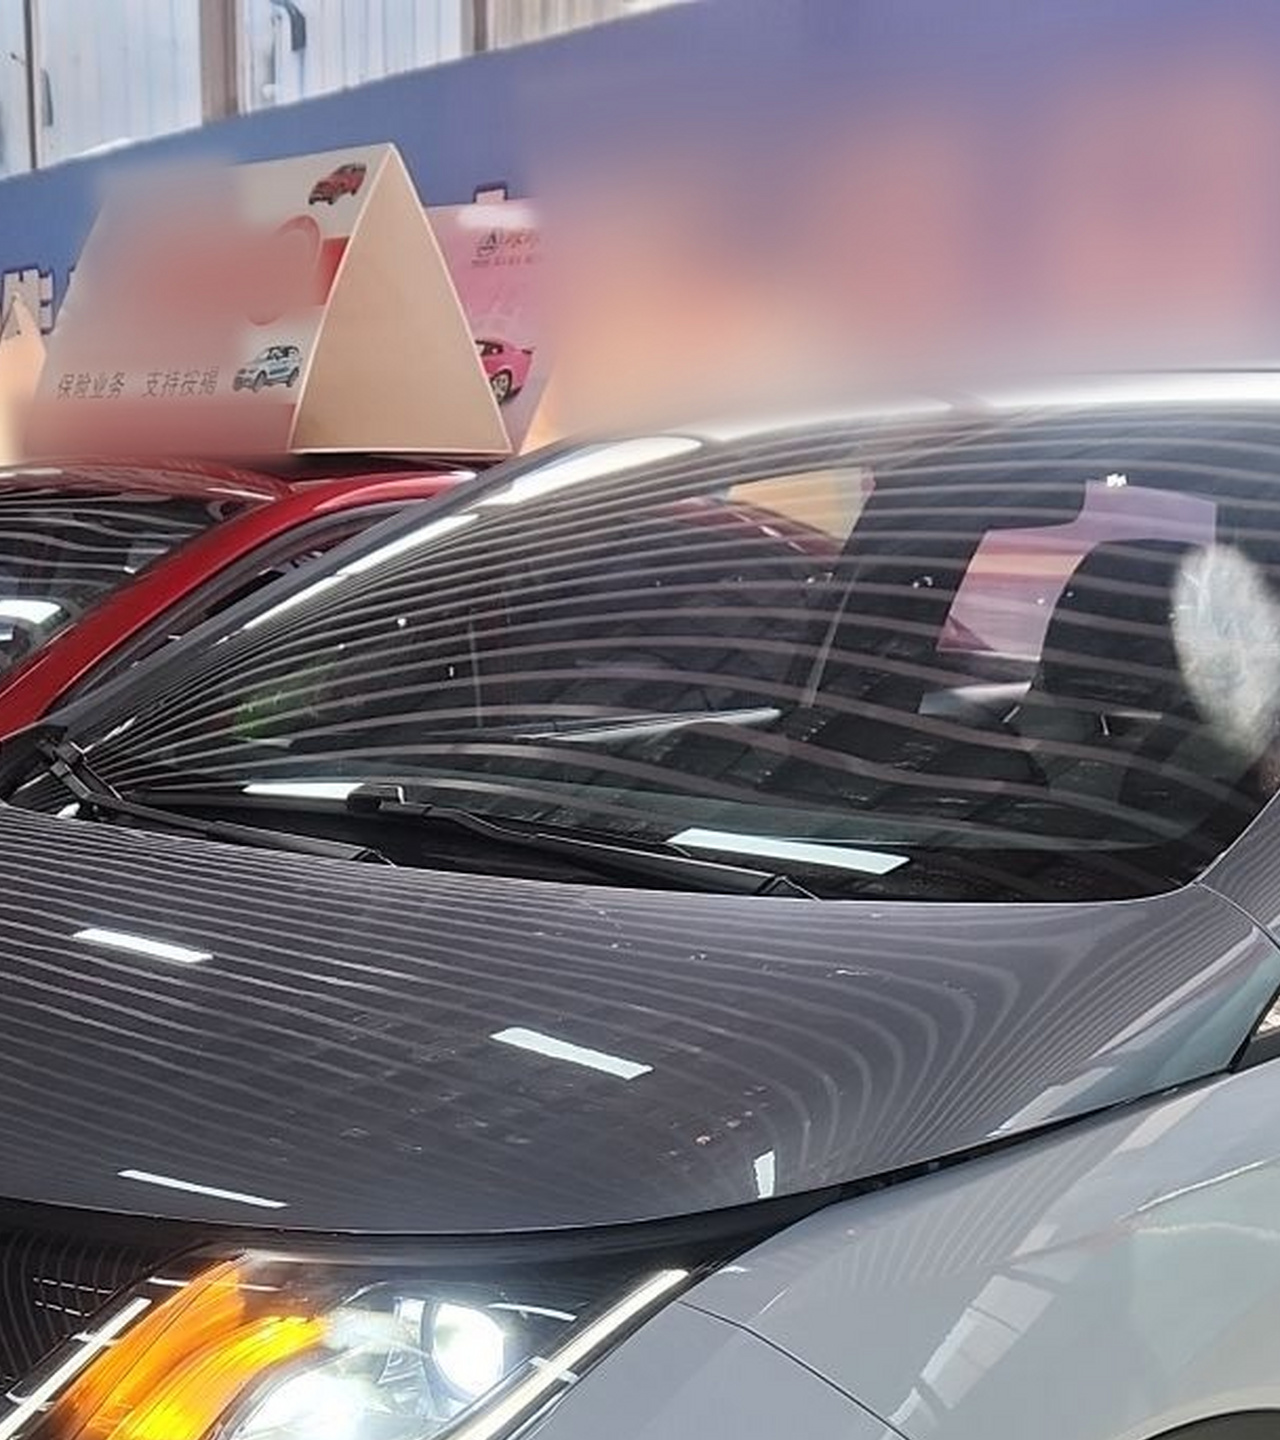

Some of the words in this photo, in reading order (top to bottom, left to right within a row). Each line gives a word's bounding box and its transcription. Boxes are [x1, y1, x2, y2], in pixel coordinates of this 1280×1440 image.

[57, 371, 126, 399] 保险业务
[142, 366, 220, 397] 支持按揭
